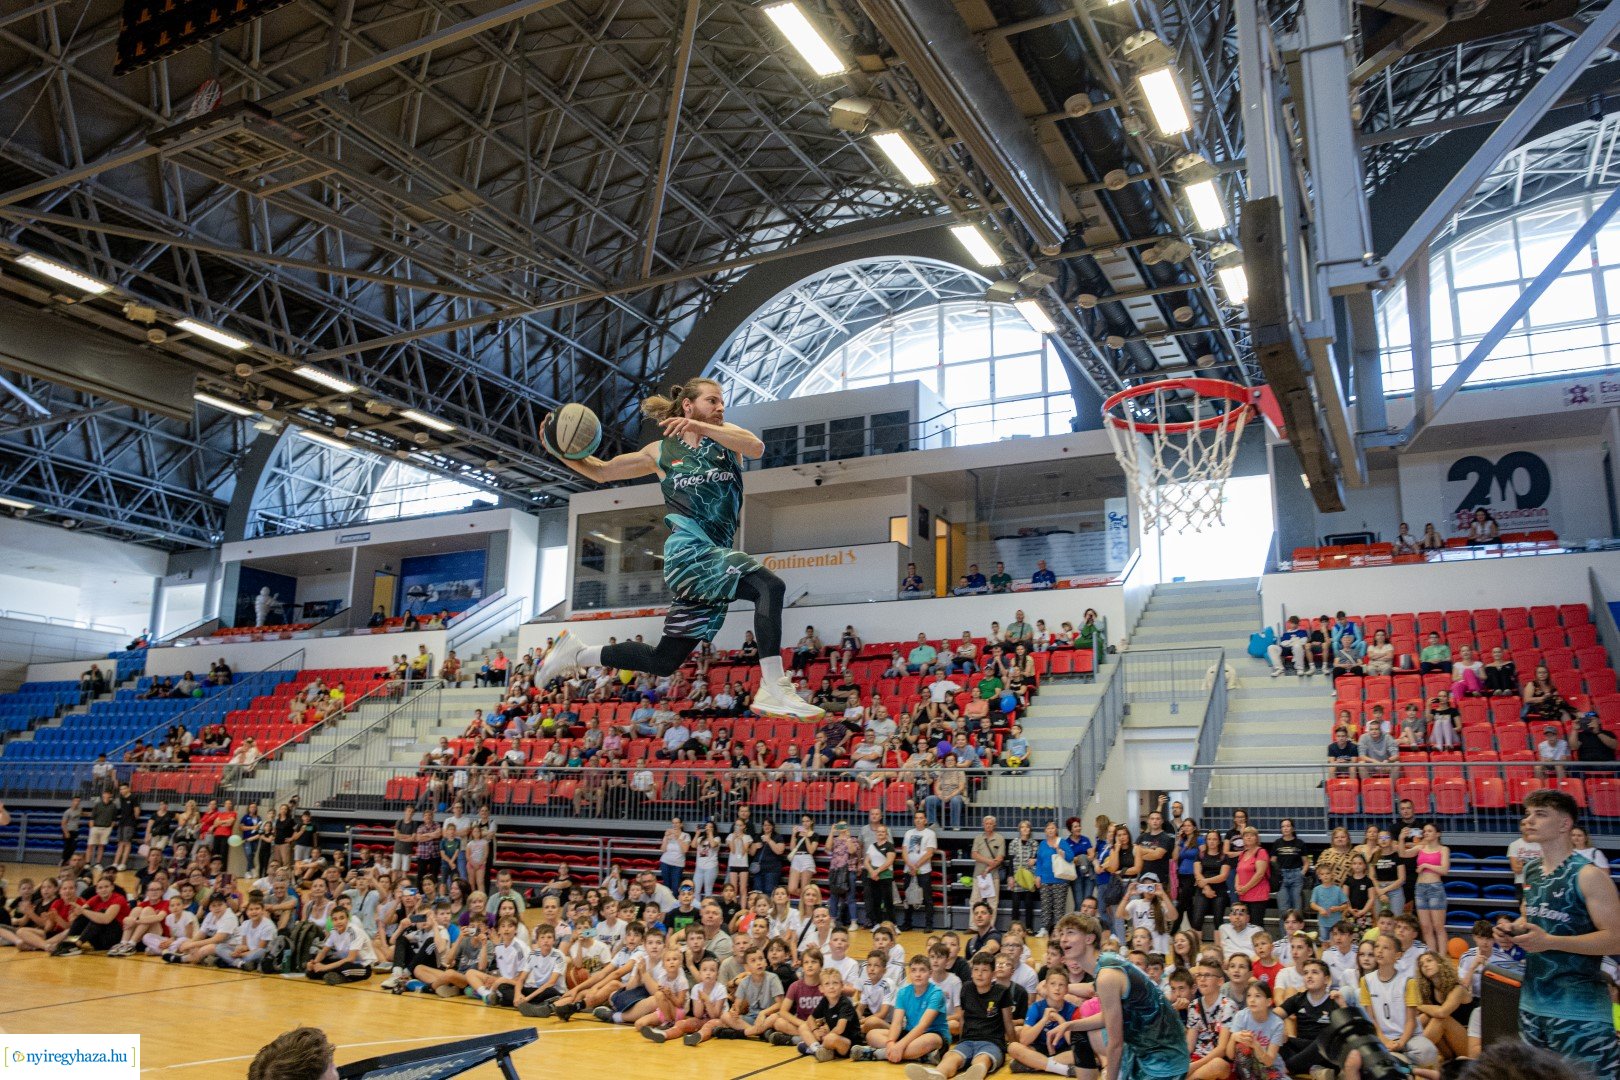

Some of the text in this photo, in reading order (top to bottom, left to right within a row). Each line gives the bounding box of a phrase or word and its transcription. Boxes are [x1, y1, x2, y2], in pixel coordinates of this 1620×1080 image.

[673, 472, 705, 490] Face
[1447, 451, 1552, 514] 20
[763, 551, 843, 571] Continental
